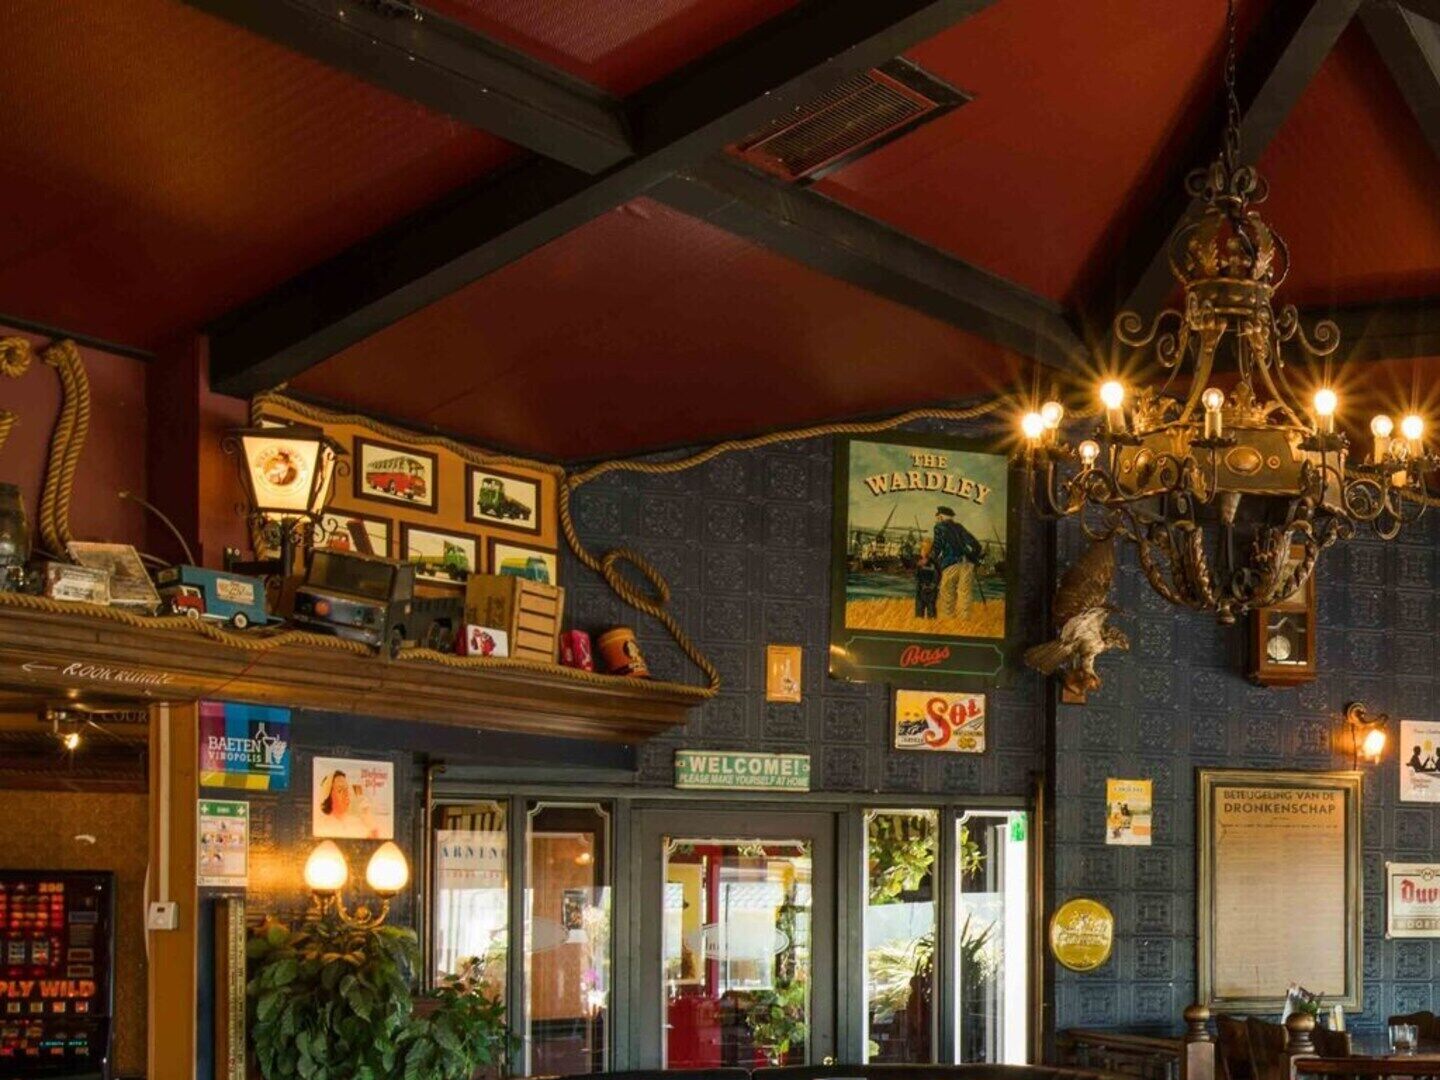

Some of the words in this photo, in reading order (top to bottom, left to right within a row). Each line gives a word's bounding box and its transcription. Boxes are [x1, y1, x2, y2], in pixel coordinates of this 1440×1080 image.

[911, 452, 949, 470] THE
[864, 470, 991, 505] WARDLEY
[208, 735, 262, 753] BAETEN
[688, 755, 800, 776] WELCOME!
[679, 773, 710, 784] PLEASE
[711, 774, 733, 785] MAKE
[736, 775, 775, 786] YOURSELF
[776, 776, 785, 786] AT
[787, 777, 809, 787] HOME
[1224, 790, 1292, 800] BETEUGELING
[1296, 791, 1319, 800] VAN
[1322, 792, 1335, 800] DE
[1224, 802, 1336, 814] DRONKENSCHAP
[40, 980, 95, 998] WILD
